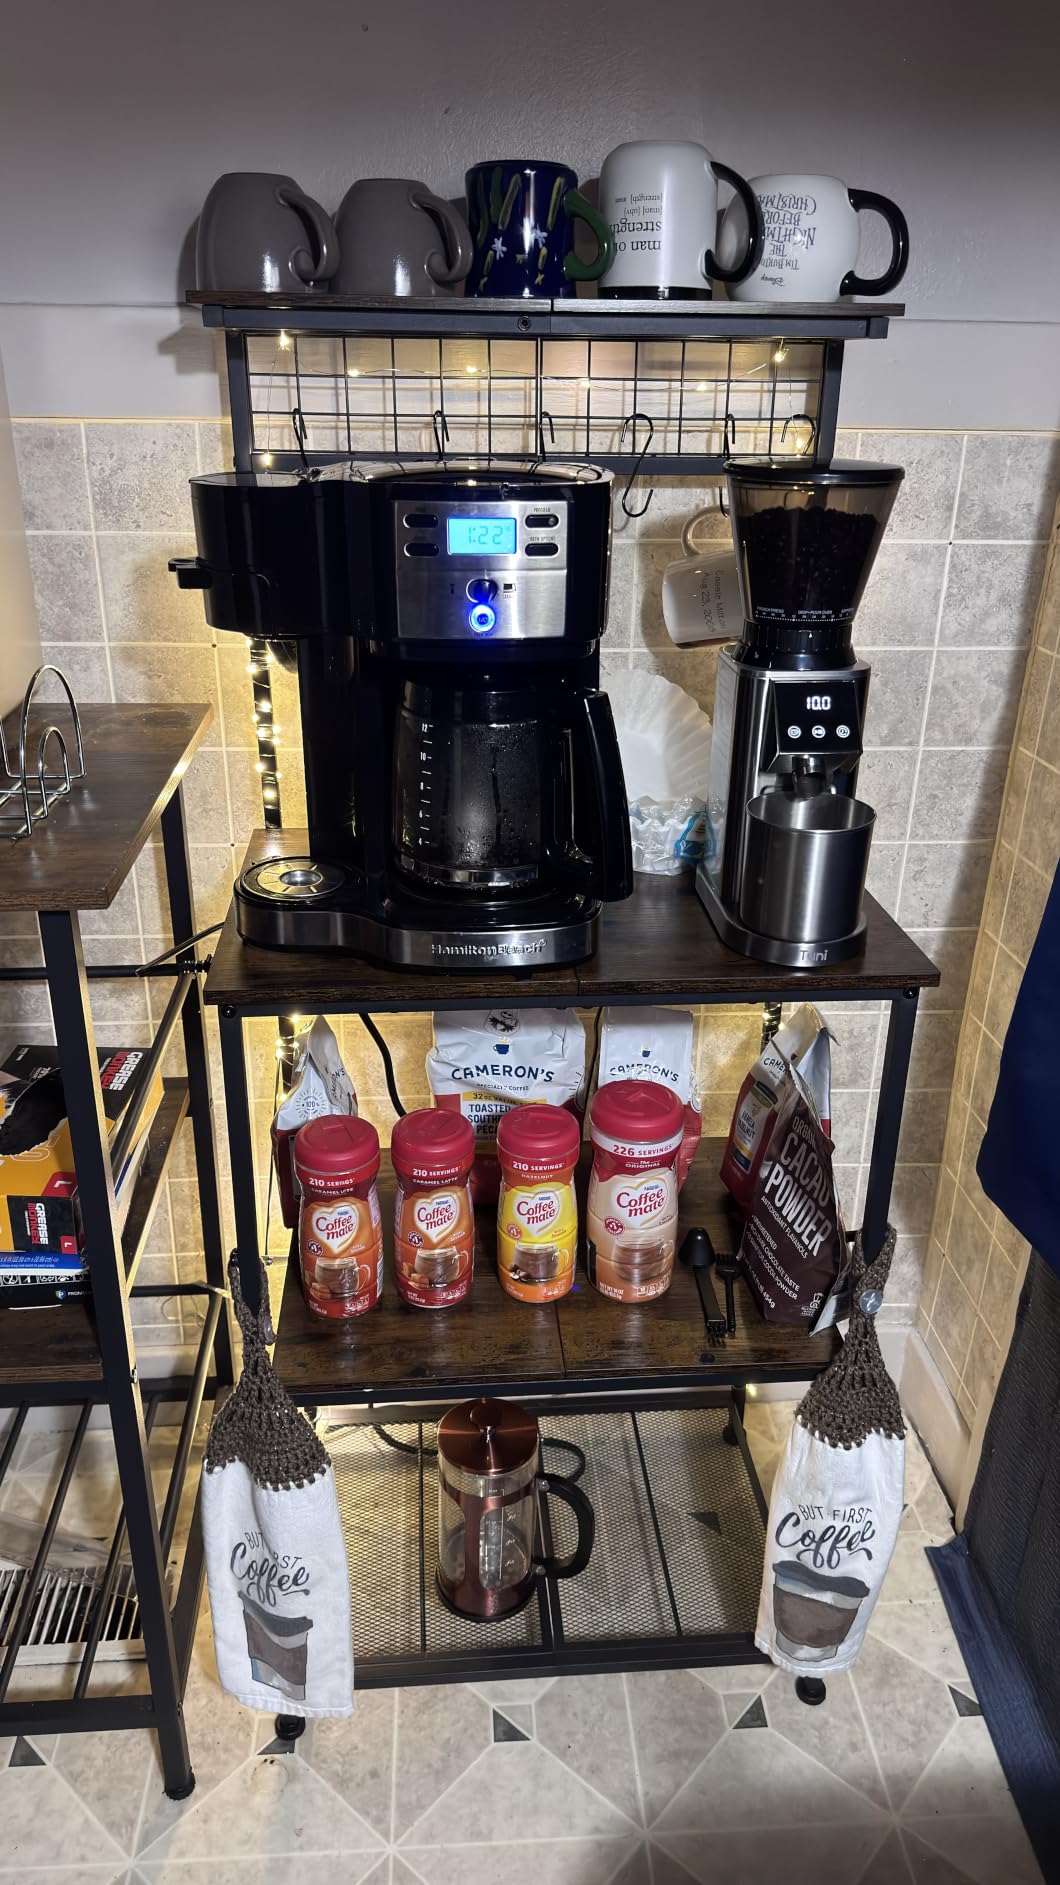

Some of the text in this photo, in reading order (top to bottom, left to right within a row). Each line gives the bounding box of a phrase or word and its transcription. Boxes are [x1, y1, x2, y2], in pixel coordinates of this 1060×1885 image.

[757, 192, 817, 215] CHRISTMA
[631, 240, 662, 251] man
[764, 227, 816, 249] NIGHTM
[769, 242, 787, 257] THE
[760, 257, 800, 270] TIM BURTO
[468, 526, 503, 545] 1:22
[420, 751, 427, 761] 10
[100, 1051, 130, 1089] MONKEY
[109, 1051, 143, 1090] GREASE
[451, 1064, 555, 1082] CAMERON'S
[472, 1092, 484, 1100] 32
[468, 1104, 511, 1113] TOASTED
[467, 1115, 502, 1123] SOUTH
[476, 1125, 498, 1134] PEC
[613, 1144, 672, 1156] 226 SERVINGS
[412, 1165, 461, 1177] 210 SERVINGS
[512, 1161, 564, 1171] 210 SERVINGS
[780, 1132, 831, 1208] CACAO
[309, 1177, 325, 1187] 210
[616, 1188, 663, 1208] Coffee
[628, 1197, 664, 1217] mate
[417, 1204, 452, 1222] Coffee
[516, 1200, 554, 1216] Coffee
[527, 1208, 556, 1225] mate
[764, 1163, 833, 1257] POWDER
[27, 1202, 41, 1245] MONKEY
[35, 1202, 49, 1245] GREASE
[315, 1215, 353, 1232] Coffee
[426, 1211, 454, 1231] mate
[326, 1223, 354, 1240] mate
[774, 1276, 799, 1300] POWDER
[781, 1272, 801, 1292] TASTE
[798, 1504, 873, 1524] BUT FIRST
[775, 1511, 875, 1569] Coffee
[244, 1531, 302, 1569] BUT RST
[230, 1541, 310, 1607] Coffee
